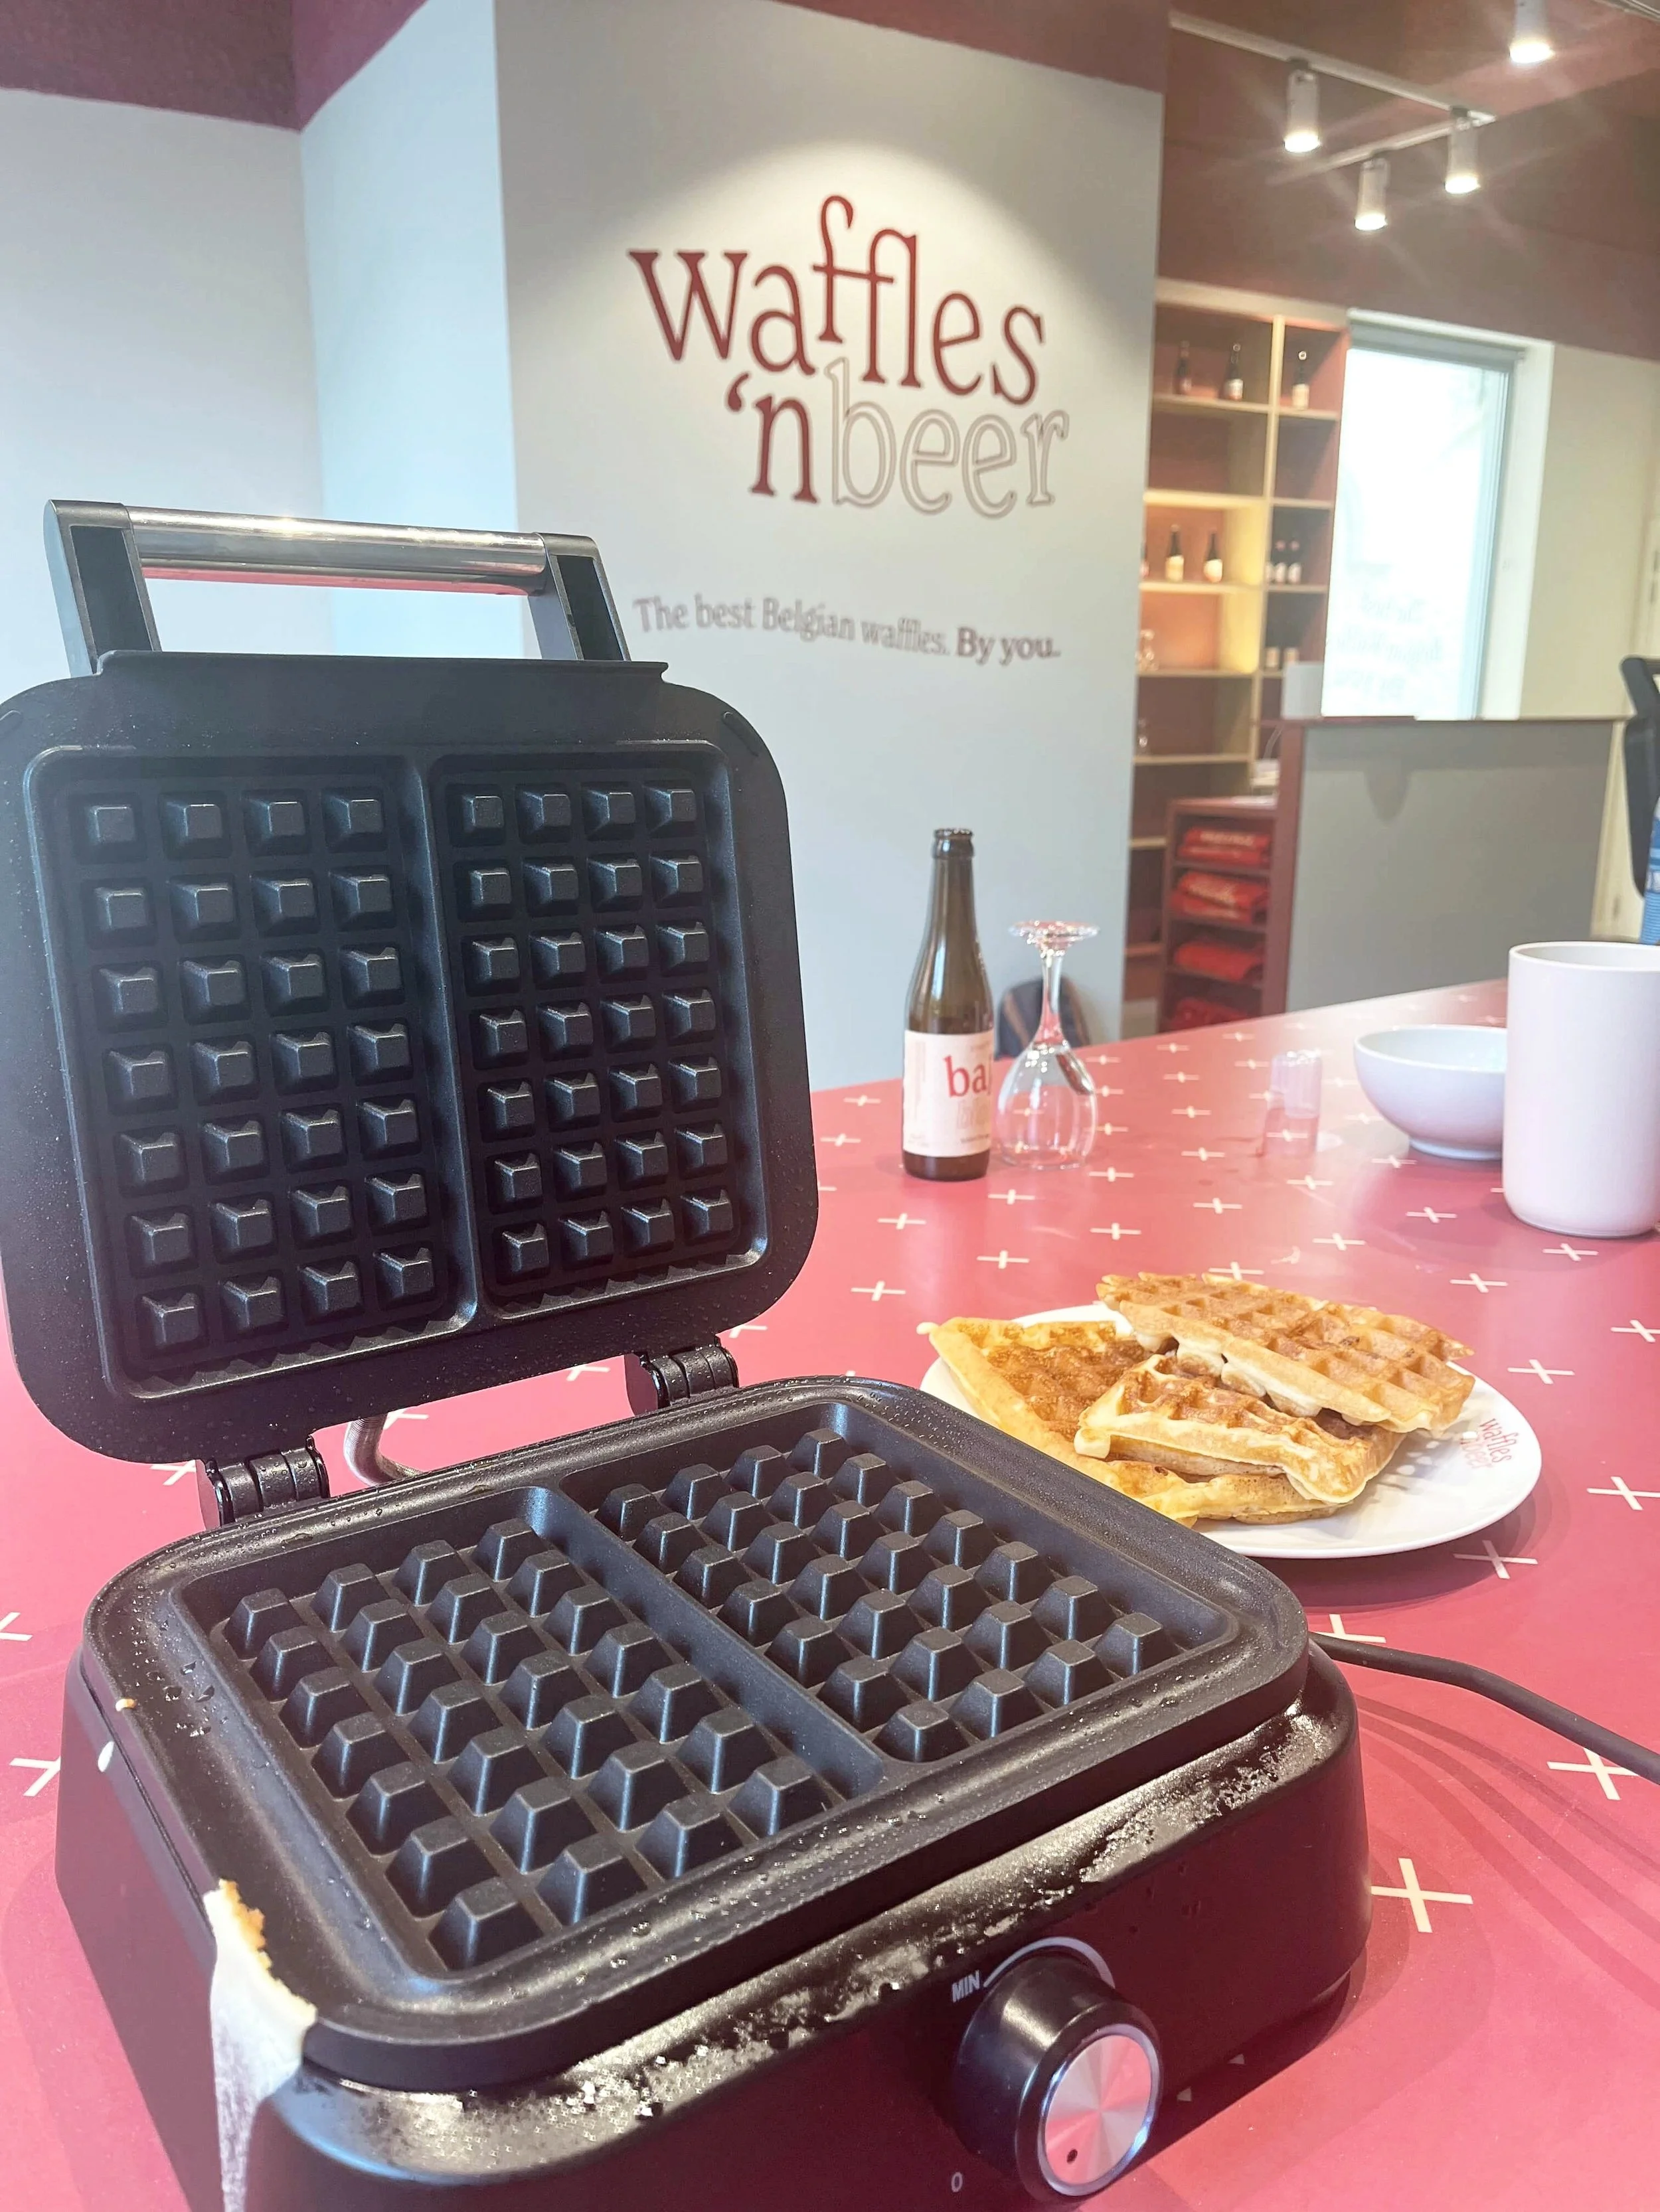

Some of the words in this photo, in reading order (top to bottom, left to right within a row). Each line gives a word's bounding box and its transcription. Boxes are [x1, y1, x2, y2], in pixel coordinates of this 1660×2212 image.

[628, 195, 1044, 406] waffles
[824, 356, 1070, 518] beer
[633, 595, 689, 633] The
[694, 594, 756, 629] best
[762, 597, 855, 642] Belgian
[862, 617, 950, 656] waffles.
[955, 626, 994, 665] By
[1000, 637, 1062, 667] you.
[951, 1970, 980, 2003] MIN
